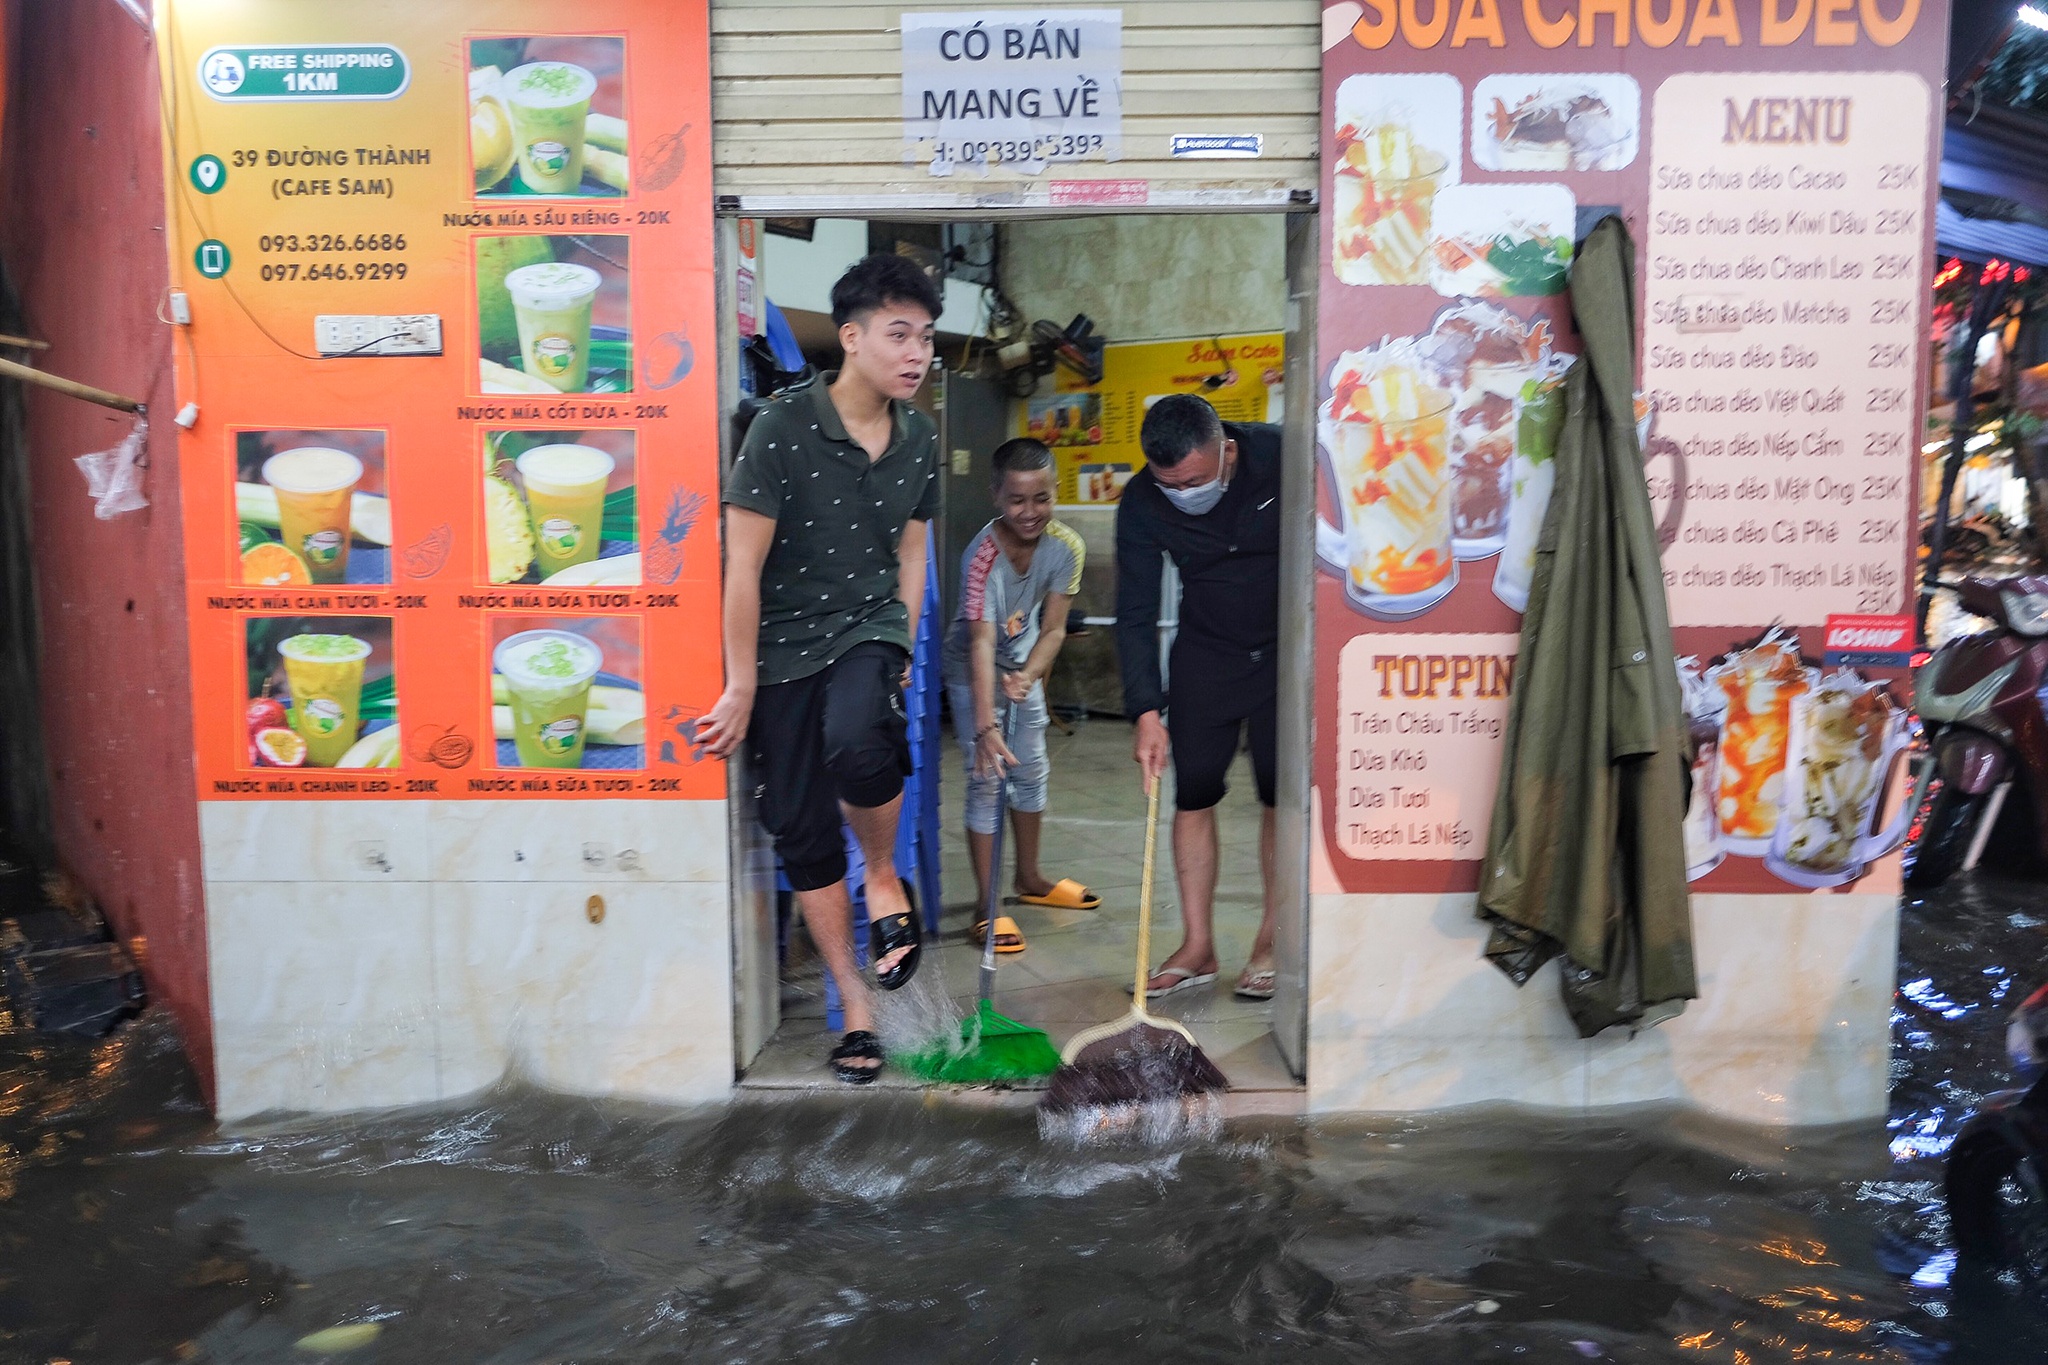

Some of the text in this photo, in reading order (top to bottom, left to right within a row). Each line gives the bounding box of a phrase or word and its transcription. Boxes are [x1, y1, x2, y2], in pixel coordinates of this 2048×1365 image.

[938, 19, 1080, 62] CÓ BÁN
[248, 53, 394, 69] FREE SHIPPING
[283, 73, 338, 91] 1KM
[922, 74, 1100, 120] MANG VỀ
[1721, 97, 1855, 146] MENU
[233, 144, 431, 167] 39 ĐƯỜNG THÀNH
[272, 177, 393, 200] (CAFE SAM)
[1698, 164, 1743, 190] chua
[1788, 164, 1848, 190] Cacao
[1877, 163, 1920, 190] 25K
[499, 209, 528, 226] MÍA
[637, 210, 670, 225] 20K
[1696, 210, 1741, 236] chua
[1874, 209, 1918, 235] 25K
[260, 233, 406, 252] 093.326.6686
[261, 262, 407, 281] 097.646.9299
[1690, 255, 1732, 280] chua
[1770, 255, 1827, 280] Chanh
[1871, 254, 1915, 280] 25K
[1781, 299, 1851, 325] Matcha
[1869, 299, 1913, 325] 25K
[1690, 344, 1736, 369] chua
[1867, 343, 1911, 369] 25K
[457, 403, 505, 420] NƯỚC
[511, 403, 542, 420] MÍA
[636, 404, 669, 419] 20K
[1684, 388, 1727, 413] chua
[1865, 387, 1908, 413] 25K
[1683, 433, 1725, 456] chua
[1862, 431, 1905, 456] 25K
[1685, 476, 1730, 500] chua
[1814, 476, 1855, 506] Ong
[1861, 476, 1904, 500] 25K
[1684, 520, 1729, 543] chua
[1858, 519, 1901, 544] 25K
[1682, 563, 1727, 587] chua
[395, 595, 427, 609] 20K
[458, 592, 508, 608] NƯỚC
[646, 594, 679, 607] 20K
[1856, 588, 1898, 613] 25K
[1371, 654, 1518, 700] TOPPIN
[406, 779, 439, 793] 20K
[648, 778, 682, 792] 20K
